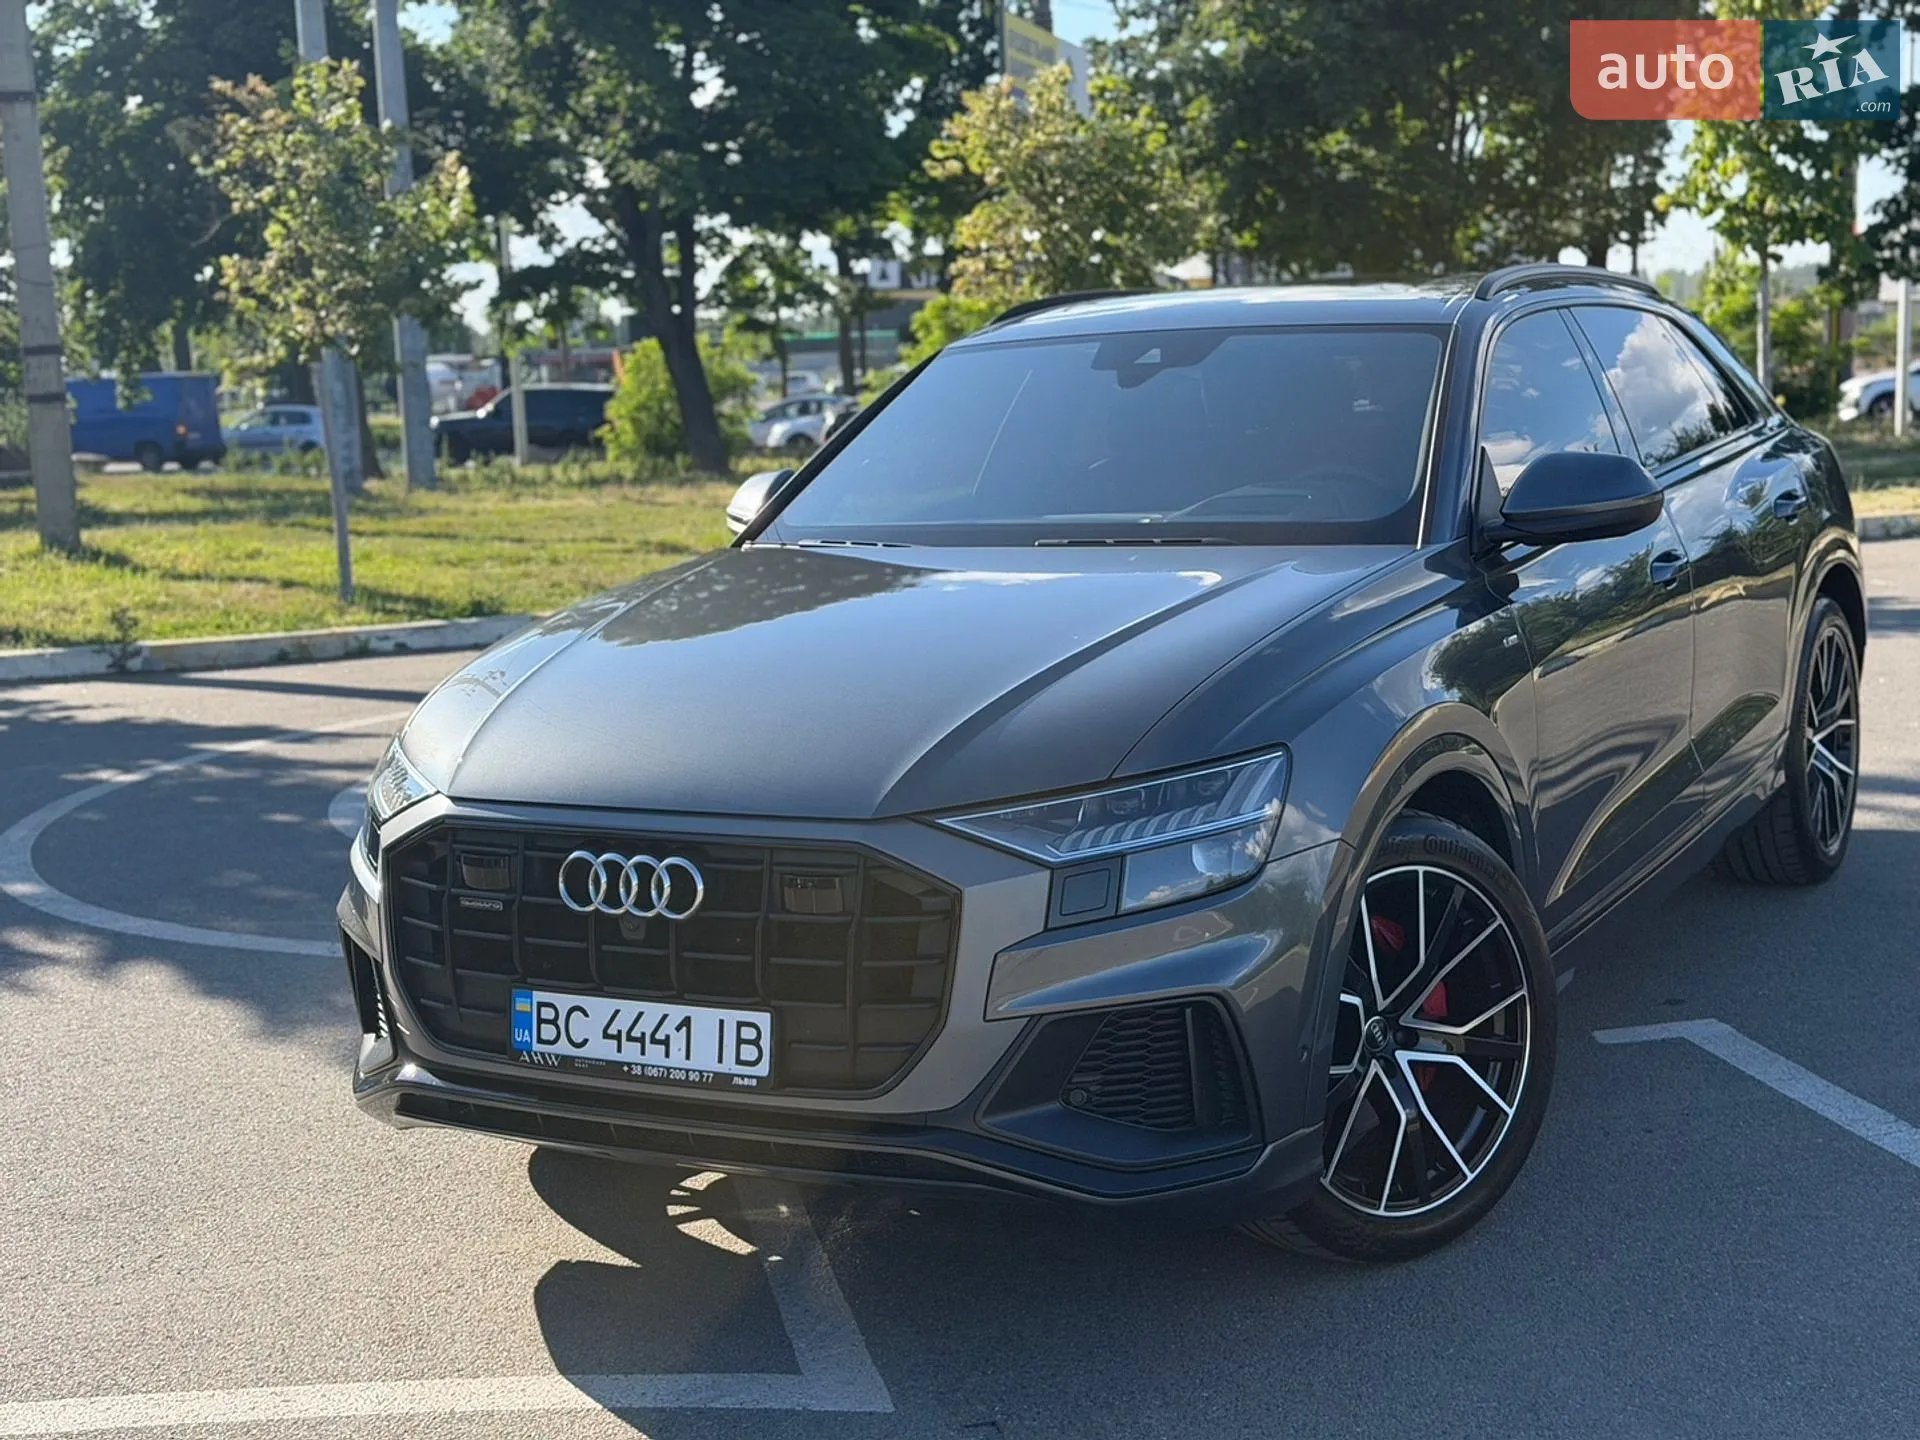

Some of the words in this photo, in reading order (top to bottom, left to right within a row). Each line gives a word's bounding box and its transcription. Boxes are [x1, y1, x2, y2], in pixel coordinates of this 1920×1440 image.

[514, 1028, 531, 1043] UA
[536, 1001, 590, 1049] BC
[602, 1009, 692, 1061] 4441
[717, 1018, 764, 1067] IB
[644, 1066, 667, 1078] (067)
[669, 1069, 687, 1080] 200
[702, 1072, 714, 1083] 77
